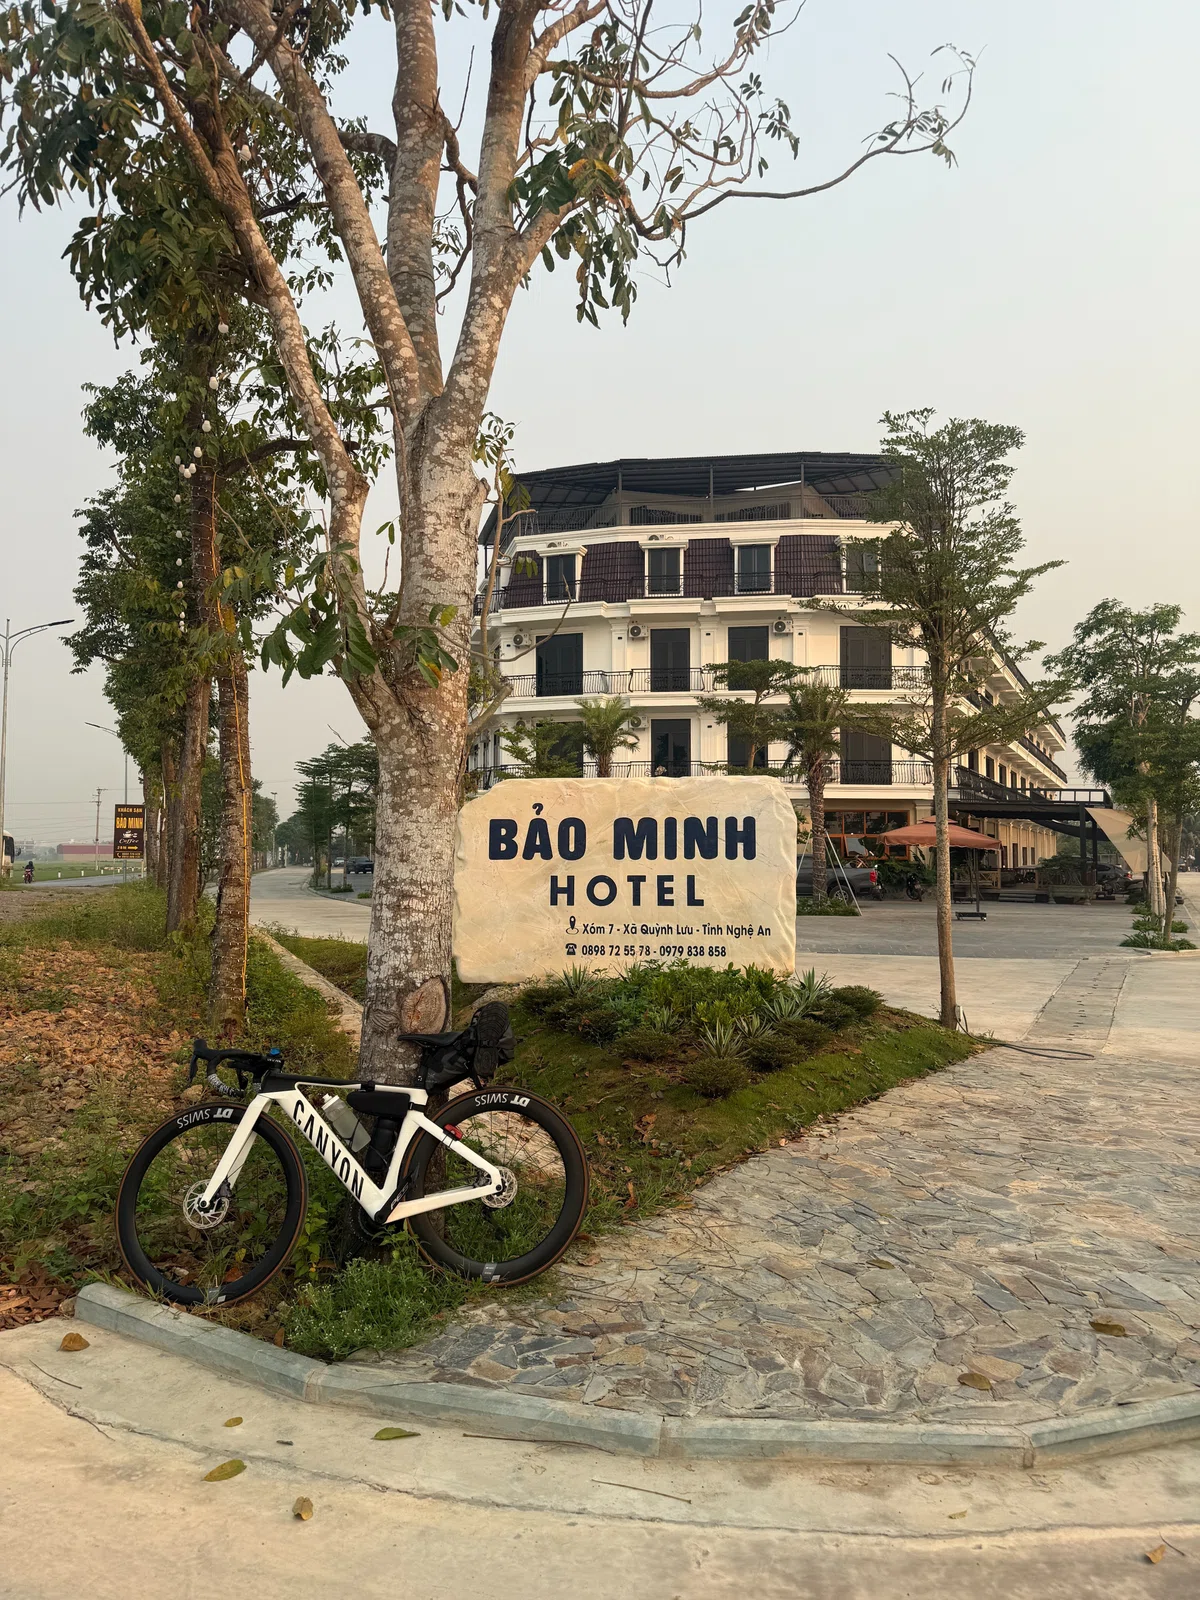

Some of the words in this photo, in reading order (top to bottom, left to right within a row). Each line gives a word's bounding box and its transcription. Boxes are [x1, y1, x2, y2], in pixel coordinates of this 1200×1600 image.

[128, 817, 143, 829] MINH
[488, 802, 587, 861] BẢO
[613, 816, 757, 861] MINH
[549, 874, 705, 907] HOTEL
[582, 923, 606, 935] Xóm
[608, 923, 614, 935] 7
[623, 923, 638, 936] Xã
[640, 922, 674, 938] Quỳnh
[676, 923, 694, 936] Lưu
[702, 922, 723, 936] Tỉnh
[726, 923, 754, 940] Nghệ
[757, 925, 771, 937] An
[581, 945, 606, 957] 0898
[608, 945, 621, 957] 72
[623, 945, 636, 957] 55
[638, 945, 651, 957] 78
[659, 945, 684, 957] 0979
[686, 946, 705, 957] 838
[707, 946, 727, 958] 858
[475, 1093, 509, 1106] SWISS
[510, 1095, 530, 1107] DT
[176, 1108, 211, 1129] SWISS
[213, 1107, 234, 1118] DT
[293, 1099, 364, 1200] CANYON
